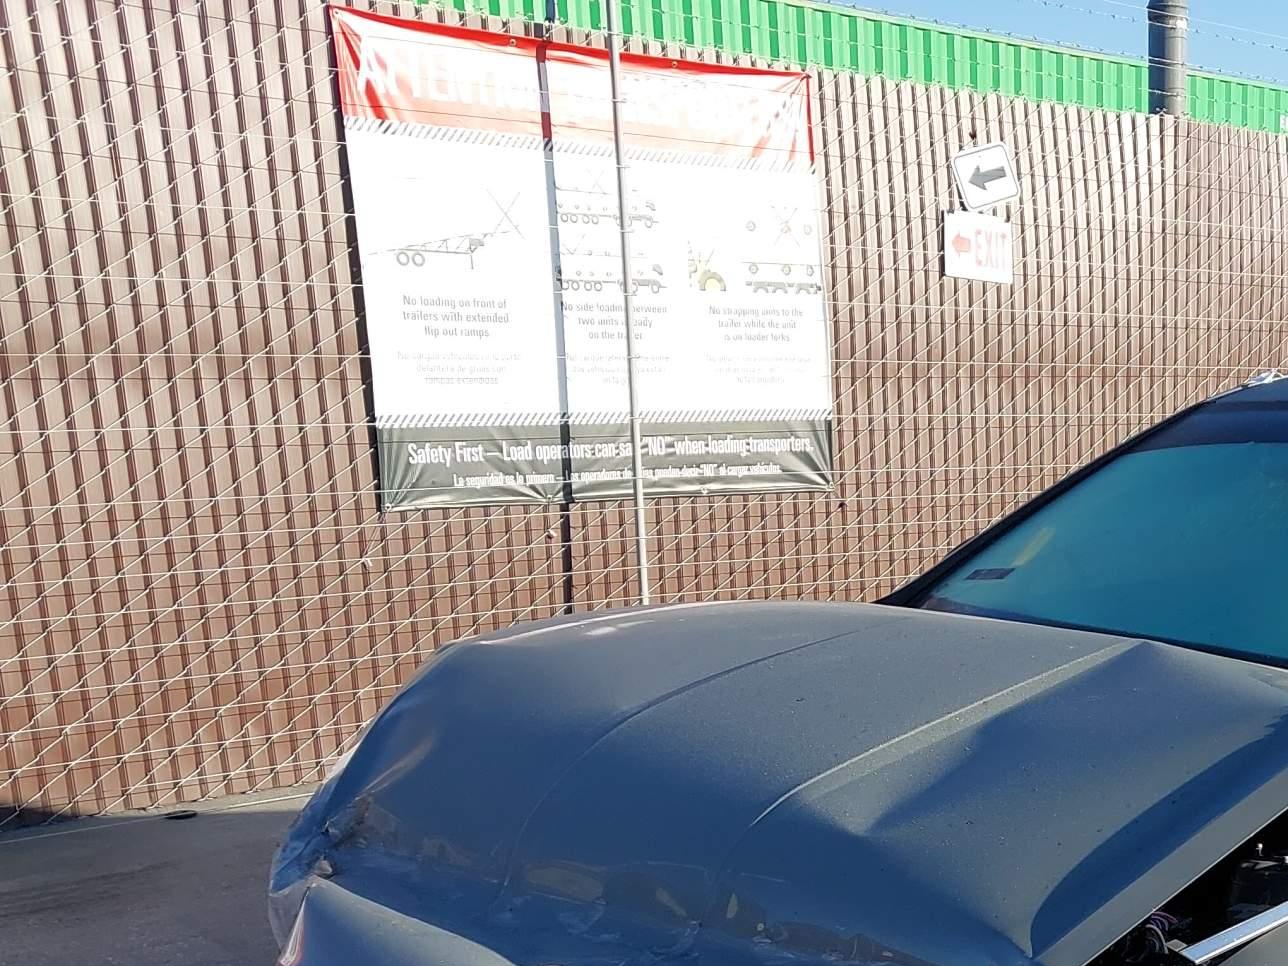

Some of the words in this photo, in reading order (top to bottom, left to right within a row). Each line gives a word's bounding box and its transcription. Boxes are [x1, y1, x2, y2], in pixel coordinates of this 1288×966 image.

[975, 229, 1008, 269] EXIT
[403, 295, 417, 306] No
[420, 296, 456, 310] loading
[459, 300, 470, 308] on
[473, 298, 495, 309] front
[497, 299, 507, 309] of
[563, 302, 573, 311] No
[576, 303, 594, 312] side
[597, 303, 629, 313] loadin
[403, 310, 438, 321] trailers
[441, 311, 463, 322] with
[465, 313, 509, 324] extended
[709, 305, 721, 315] No
[723, 306, 759, 317] strapping
[782, 308, 789, 317] to
[791, 307, 803, 317] the
[578, 317, 595, 326] two
[598, 317, 618, 326] units
[621, 318, 653, 328] eady
[718, 319, 741, 329] trailer
[744, 319, 766, 329] while
[768, 319, 780, 329] the
[782, 320, 797, 329] unit
[424, 325, 440, 338] flip
[442, 327, 458, 337] out
[460, 328, 490, 340] ramps
[588, 332, 599, 340] on
[601, 330, 615, 340] the
[617, 332, 642, 341] trer
[408, 442, 451, 467] Safety
[454, 441, 484, 463] First
[502, 440, 532, 461] Load
[535, 440, 592, 464] operators
[593, 443, 615, 459] can
[618, 443, 640, 459] sa
[674, 435, 705, 455] when
[708, 433, 749, 457] loading
[750, 436, 814, 456] transporters.
[453, 473, 466, 486] La
[466, 472, 503, 488] seguridad
[504, 474, 516, 485] es
[516, 472, 525, 485] lo
[525, 472, 555, 487] primero
